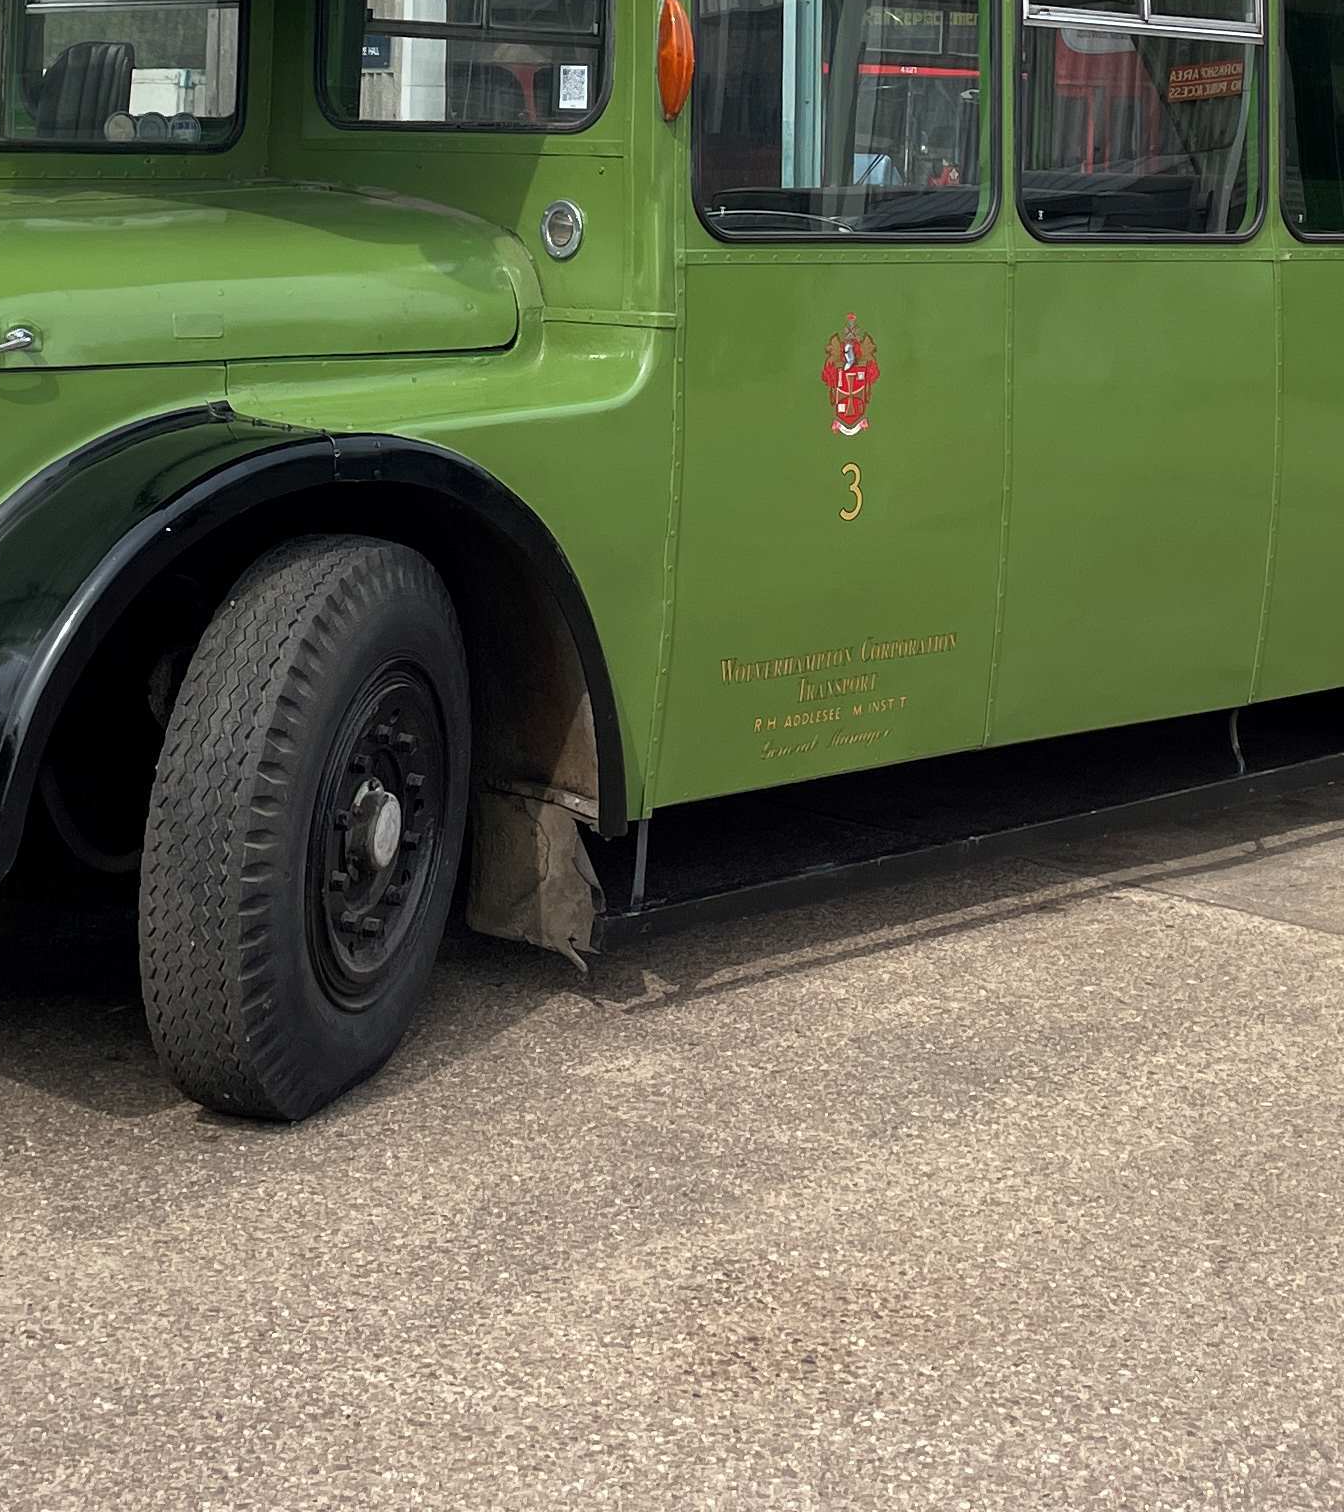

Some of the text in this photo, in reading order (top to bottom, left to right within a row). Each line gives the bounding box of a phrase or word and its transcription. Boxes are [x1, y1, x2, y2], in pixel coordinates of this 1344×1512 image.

[838, 461, 864, 522] 3
[798, 672, 879, 704] TRANSPORT
[783, 707, 841, 729] ADDLESEE
